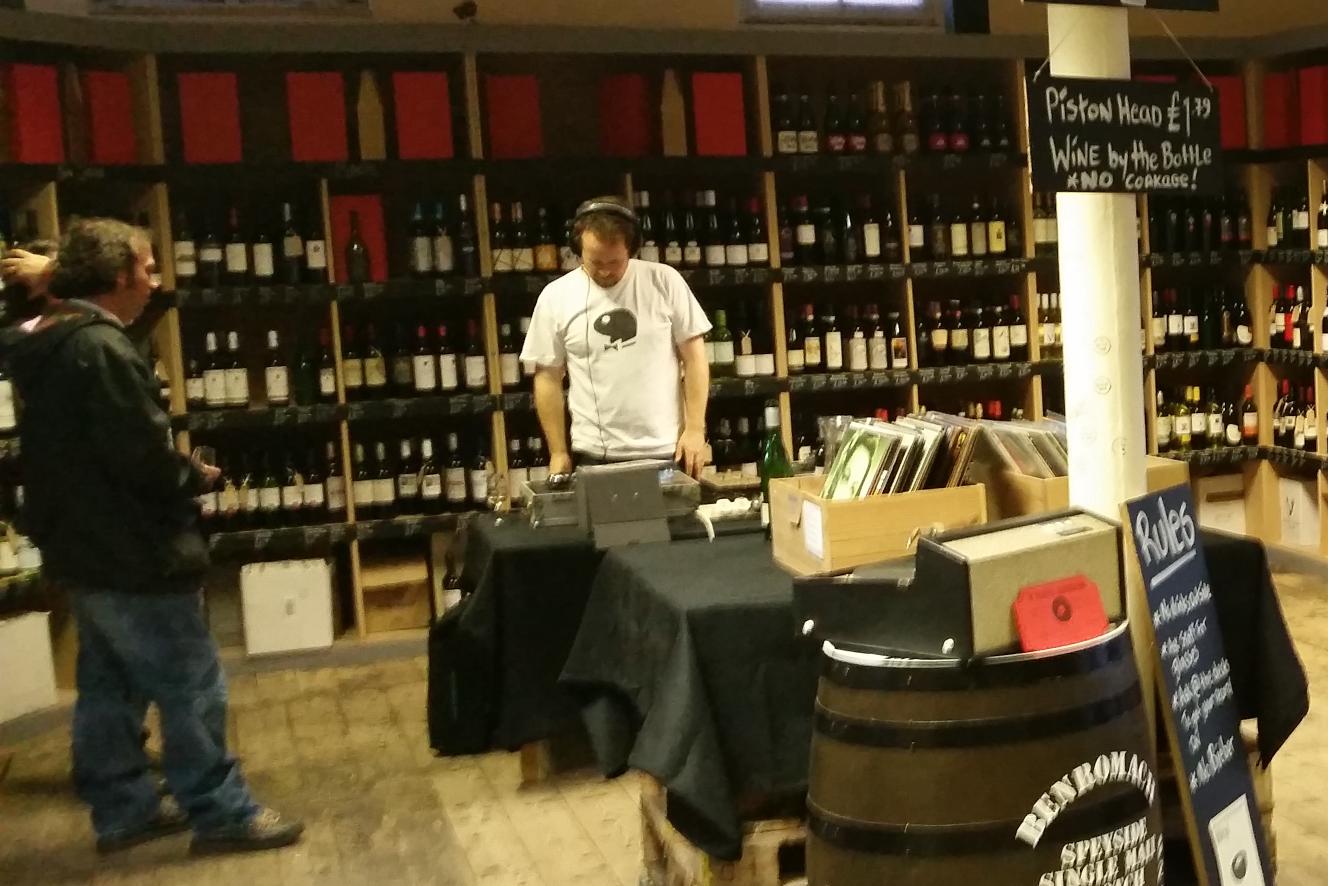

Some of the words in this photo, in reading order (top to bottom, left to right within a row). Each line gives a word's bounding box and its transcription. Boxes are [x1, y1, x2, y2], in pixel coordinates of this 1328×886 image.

[1108, 142, 1129, 181] by
[1131, 140, 1158, 171] the
[1135, 496, 1197, 568] Rules
[1015, 750, 1156, 849] BENROMACH
[1061, 816, 1148, 870] SPEYSIDE
